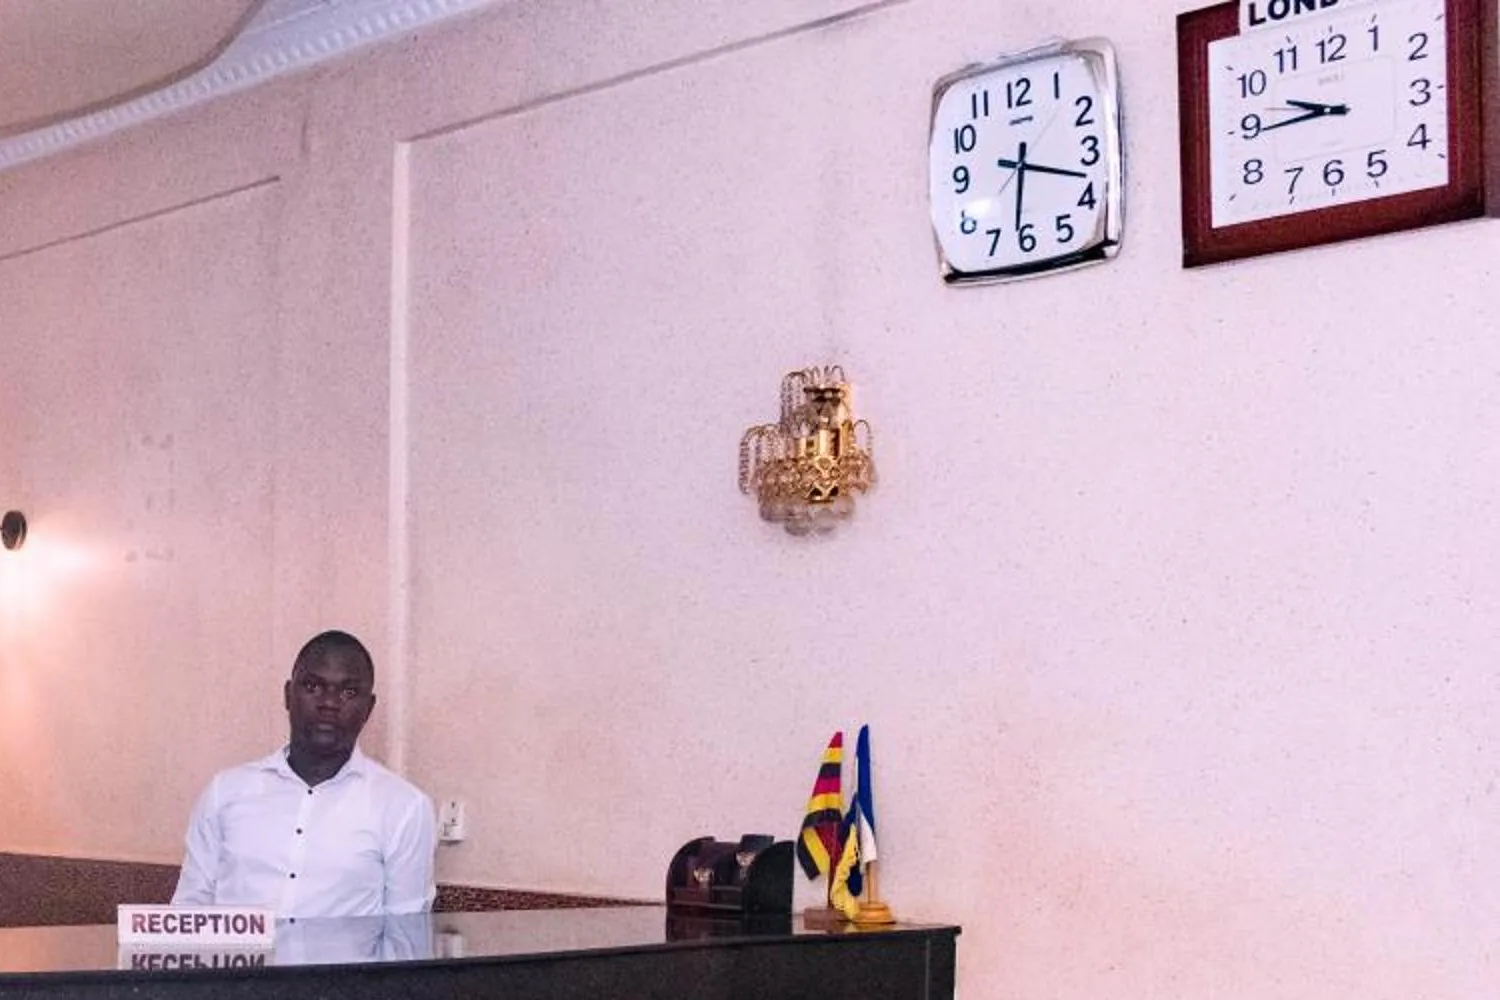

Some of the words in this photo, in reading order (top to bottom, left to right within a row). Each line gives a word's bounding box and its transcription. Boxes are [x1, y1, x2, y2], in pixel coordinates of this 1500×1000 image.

[1317, 35, 1346, 63] 12
[1368, 26, 1377, 51] 1
[1409, 34, 1427, 60] 2
[1275, 46, 1296, 72] 11
[1007, 78, 1031, 108] 12
[1053, 72, 1060, 99] 1
[1238, 70, 1266, 97] 10
[1410, 79, 1430, 106] 3
[971, 90, 989, 119] 11
[1076, 96, 1093, 126] 2
[955, 125, 976, 153] 10
[1241, 114, 1260, 139] 9
[1408, 124, 1430, 148] 4
[1081, 136, 1099, 166] 3
[1368, 150, 1387, 177] 5
[953, 166, 969, 193] 9
[1244, 160, 1263, 184] 8
[1285, 167, 1303, 193] 7
[1324, 160, 1344, 186] 6
[1078, 182, 1096, 209] 4
[1019, 223, 1037, 252] 6
[1056, 214, 1073, 242] 5
[986, 229, 1000, 256] 7
[133, 914, 264, 934] RECEPTION
